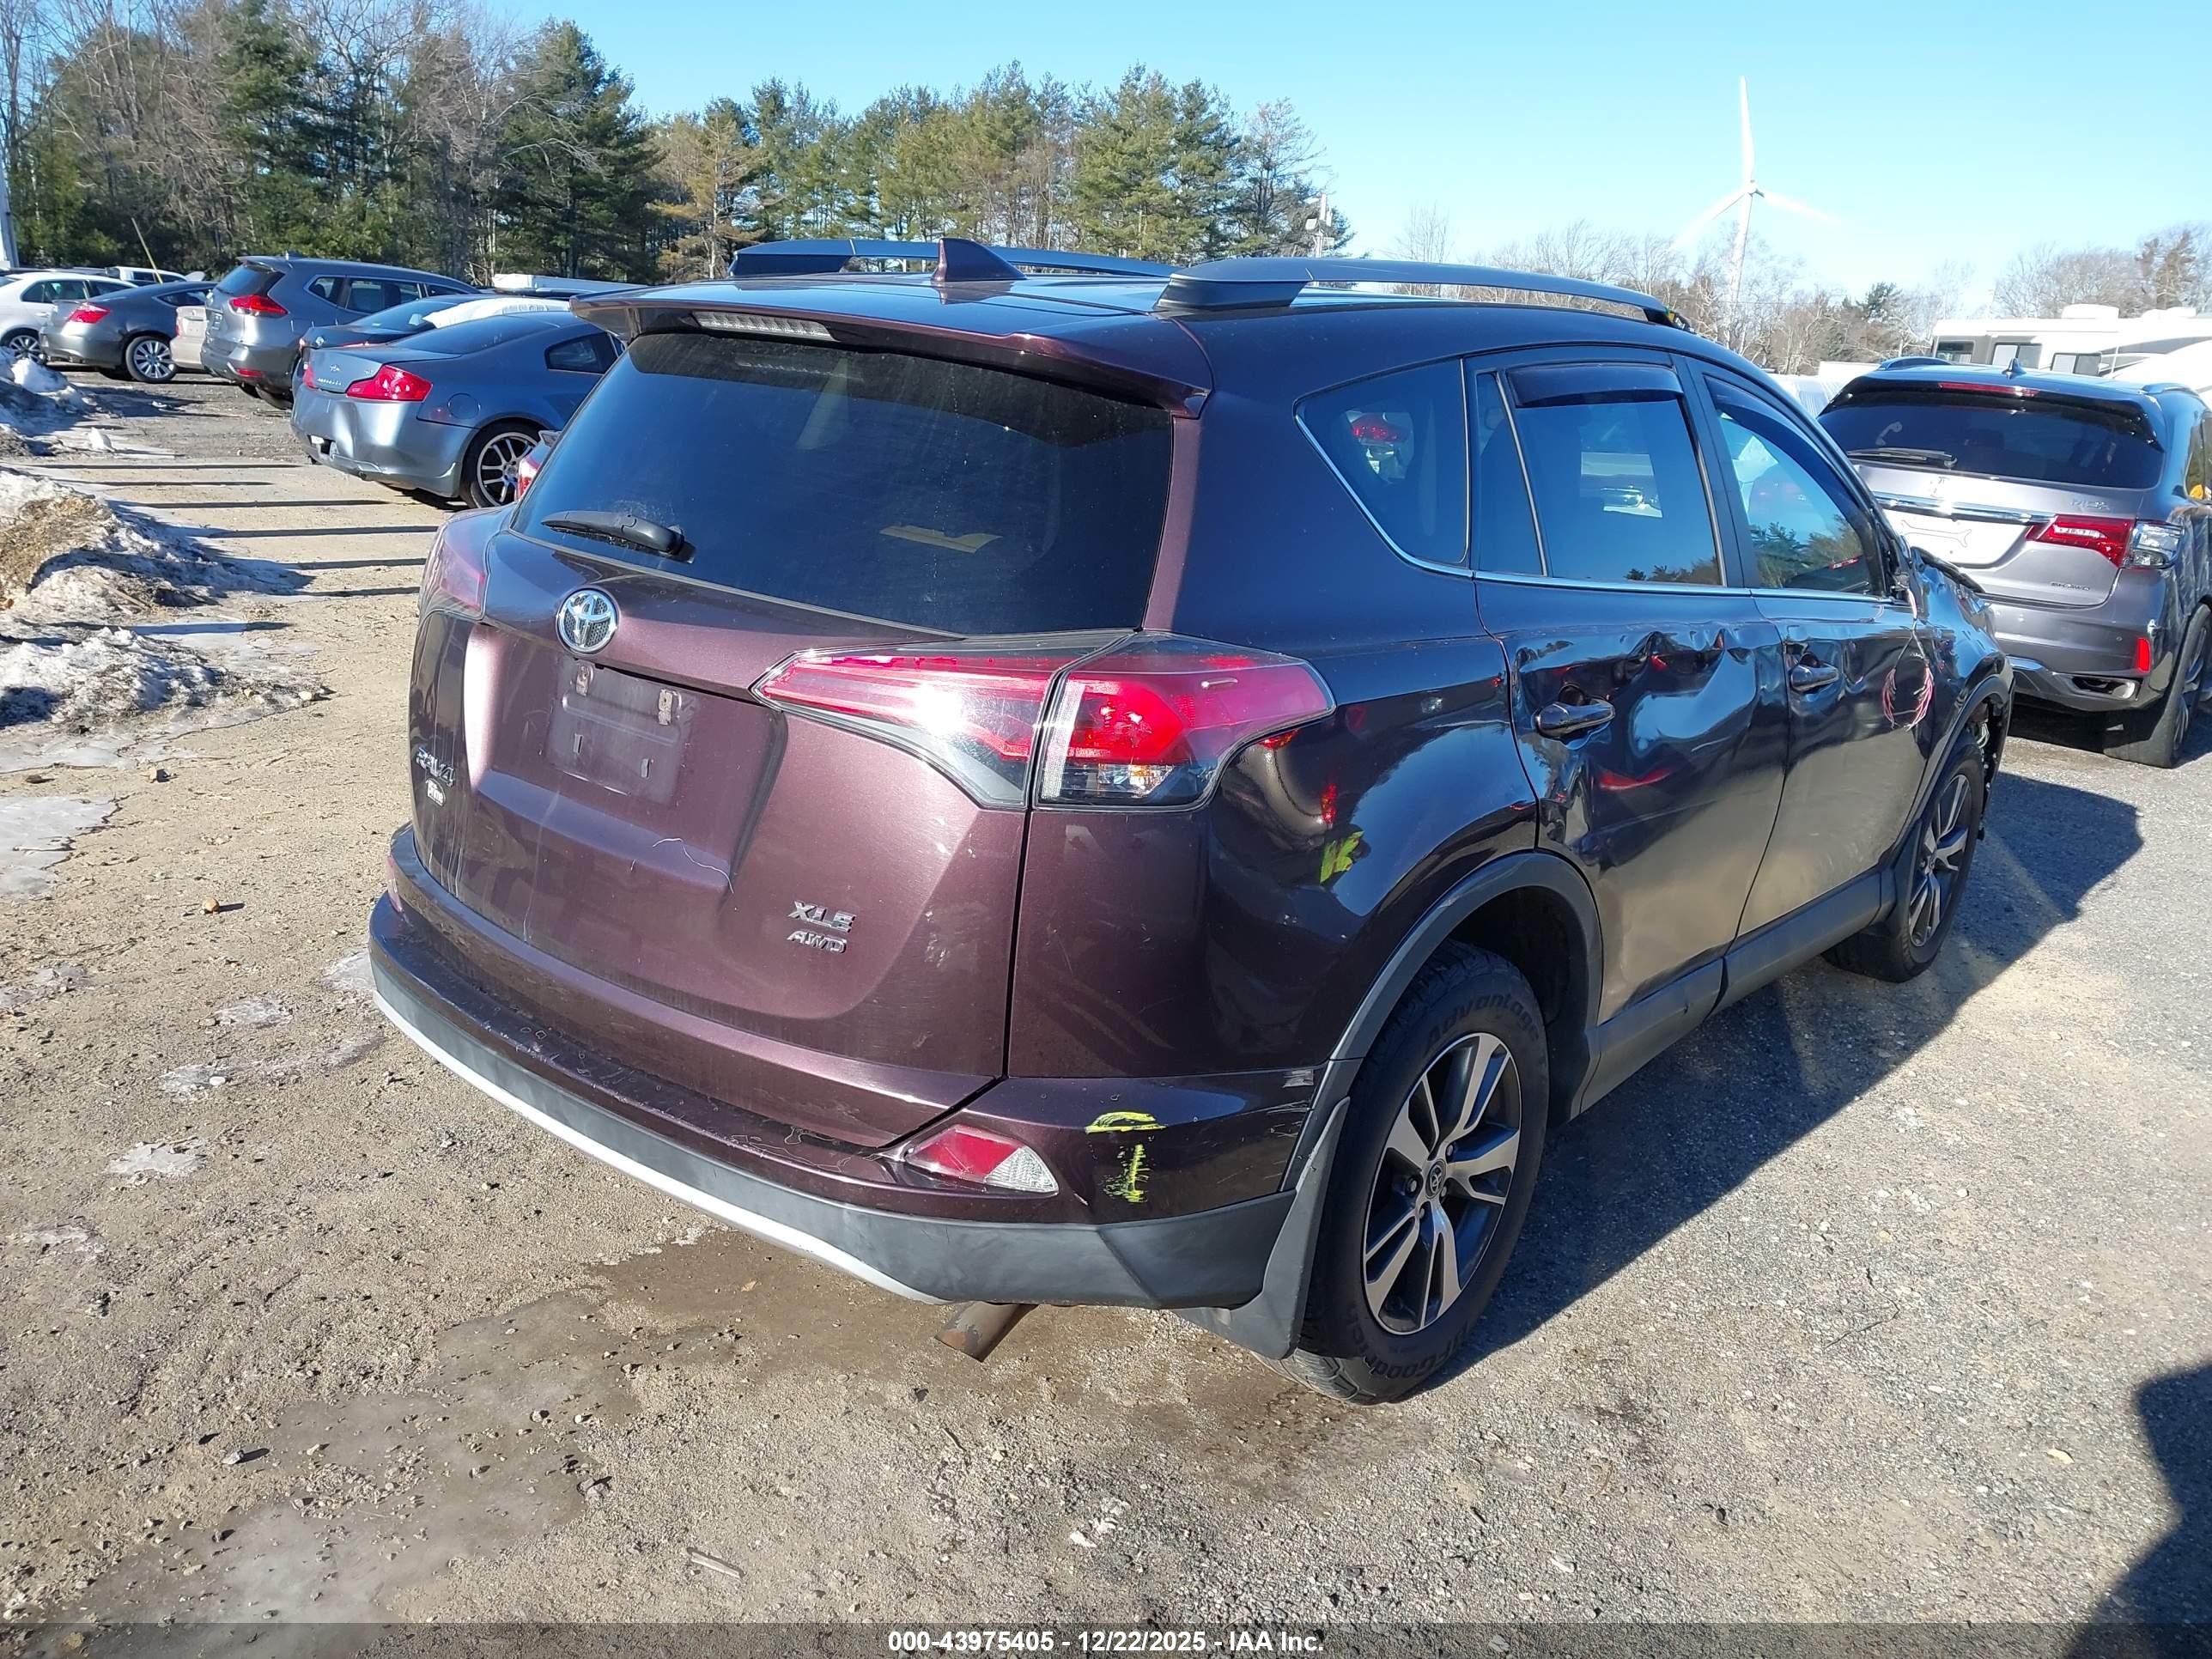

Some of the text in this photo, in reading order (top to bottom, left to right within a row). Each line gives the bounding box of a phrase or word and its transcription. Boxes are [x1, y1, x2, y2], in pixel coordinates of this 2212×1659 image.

[416, 745, 454, 787] RAV4
[787, 900, 857, 933] XLE
[787, 930, 848, 954] AWD
